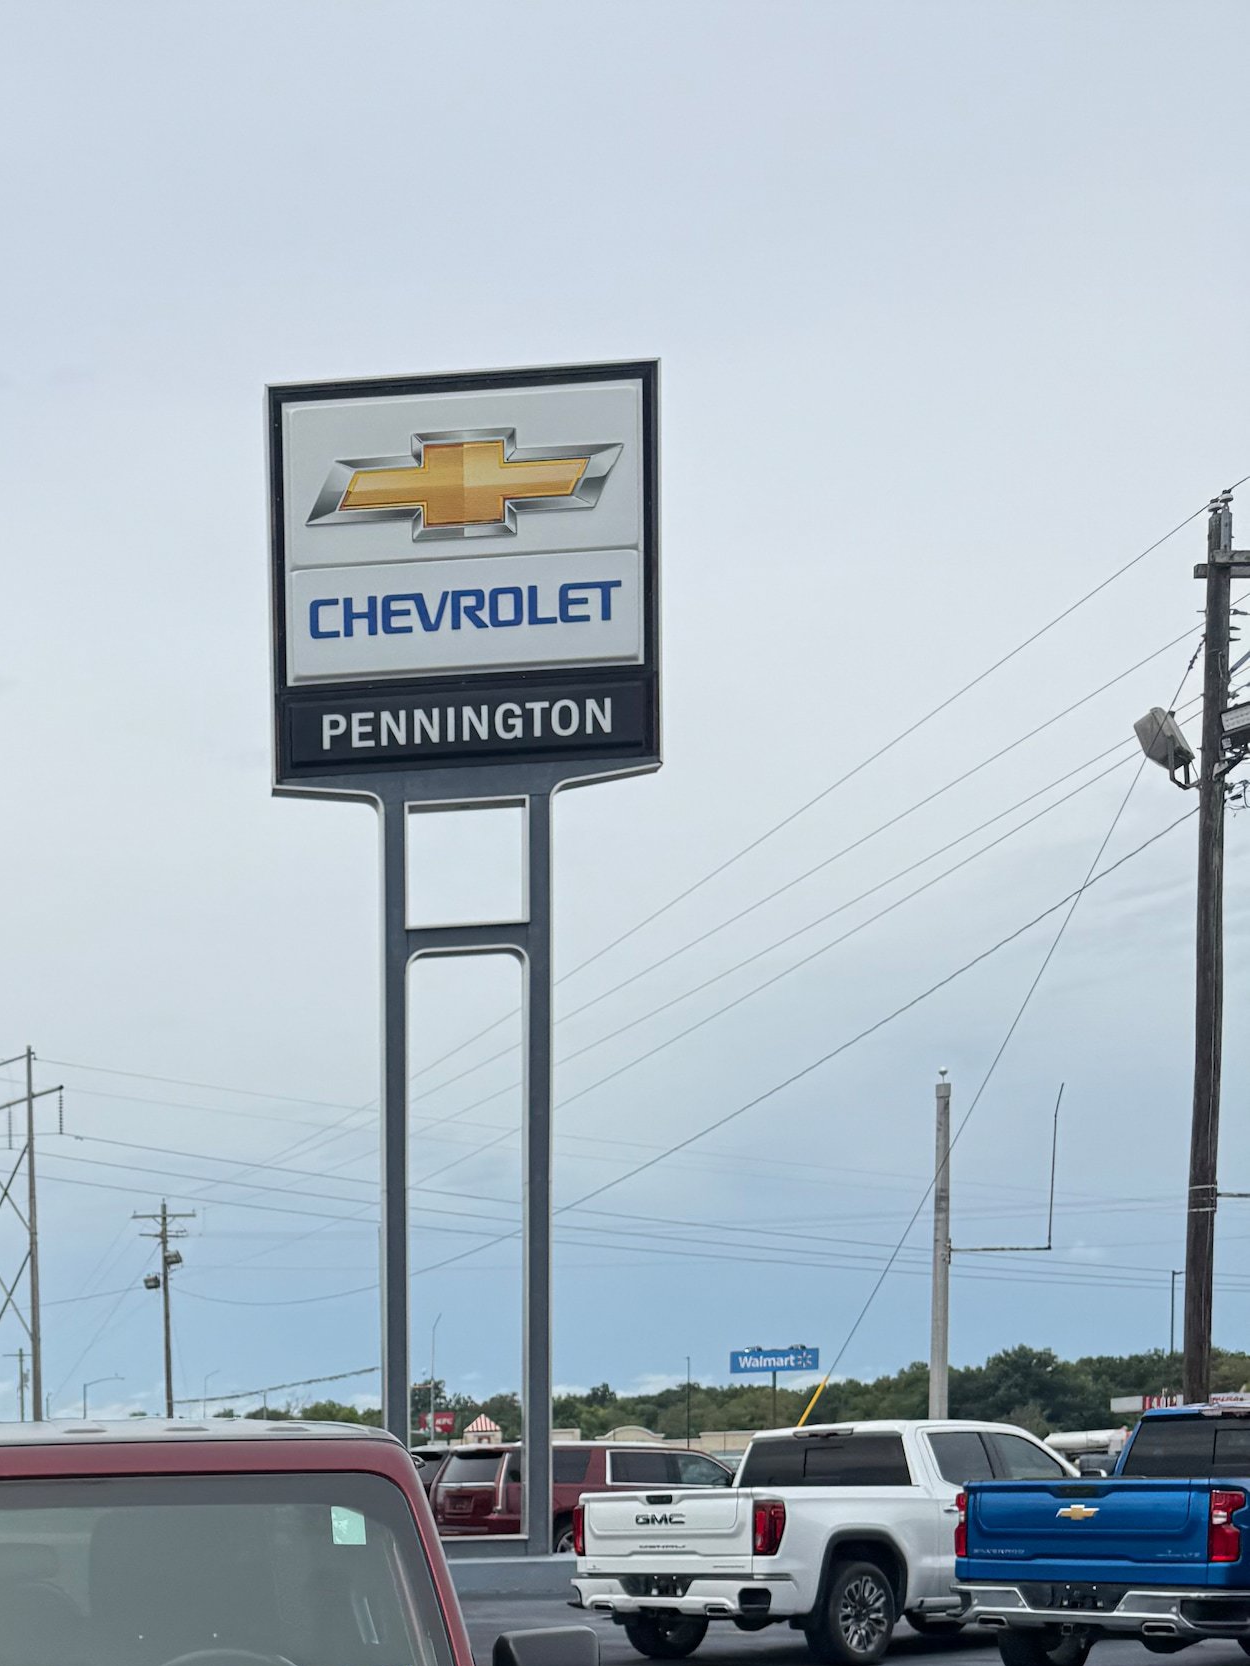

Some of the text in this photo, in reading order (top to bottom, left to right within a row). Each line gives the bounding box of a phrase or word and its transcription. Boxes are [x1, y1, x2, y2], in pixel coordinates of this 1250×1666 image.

[309, 580, 622, 639] CHEVROLET
[321, 697, 612, 750] PENNINGTON
[738, 1354, 795, 1369] Walmart
[635, 1513, 686, 1526] GMC
